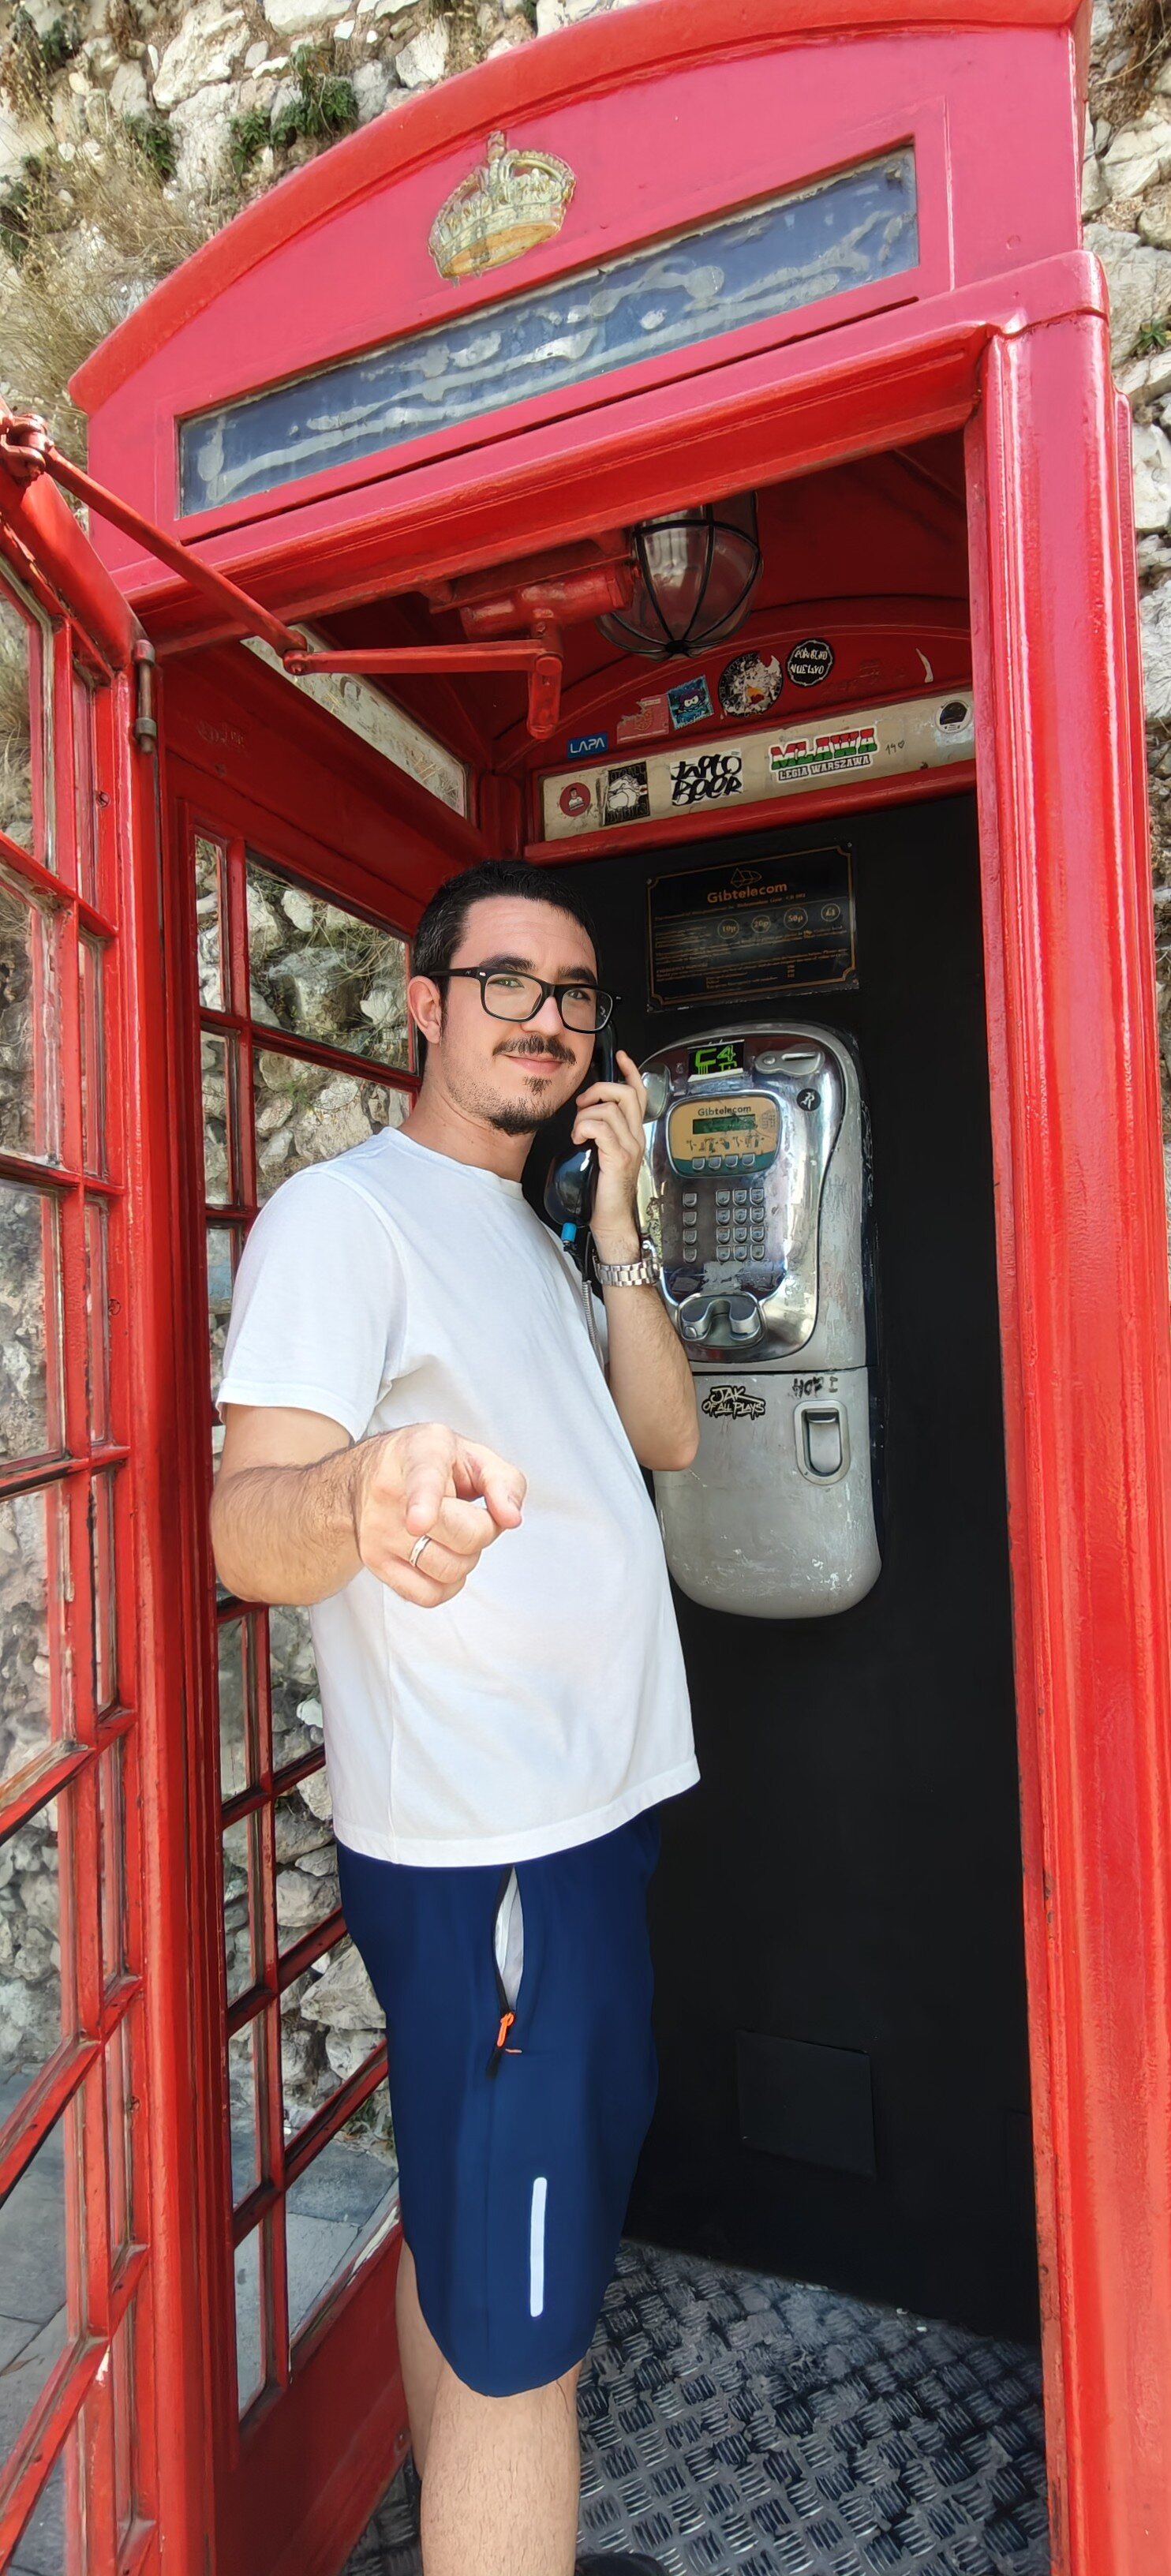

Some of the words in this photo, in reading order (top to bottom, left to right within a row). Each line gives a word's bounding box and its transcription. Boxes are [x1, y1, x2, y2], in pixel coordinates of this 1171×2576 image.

[570, 737, 605, 754] LAPA
[779, 766, 809, 781] LEGIA
[810, 754, 870, 775] WARSZAWA
[707, 882, 788, 904] Gibtelecom
[698, 1106, 751, 1117] Gibtelecom
[710, 1387, 765, 1404] JAK
[702, 1400, 716, 1413] OF
[716, 1402, 733, 1414] ALL
[733, 1401, 765, 1419] PLAYS
